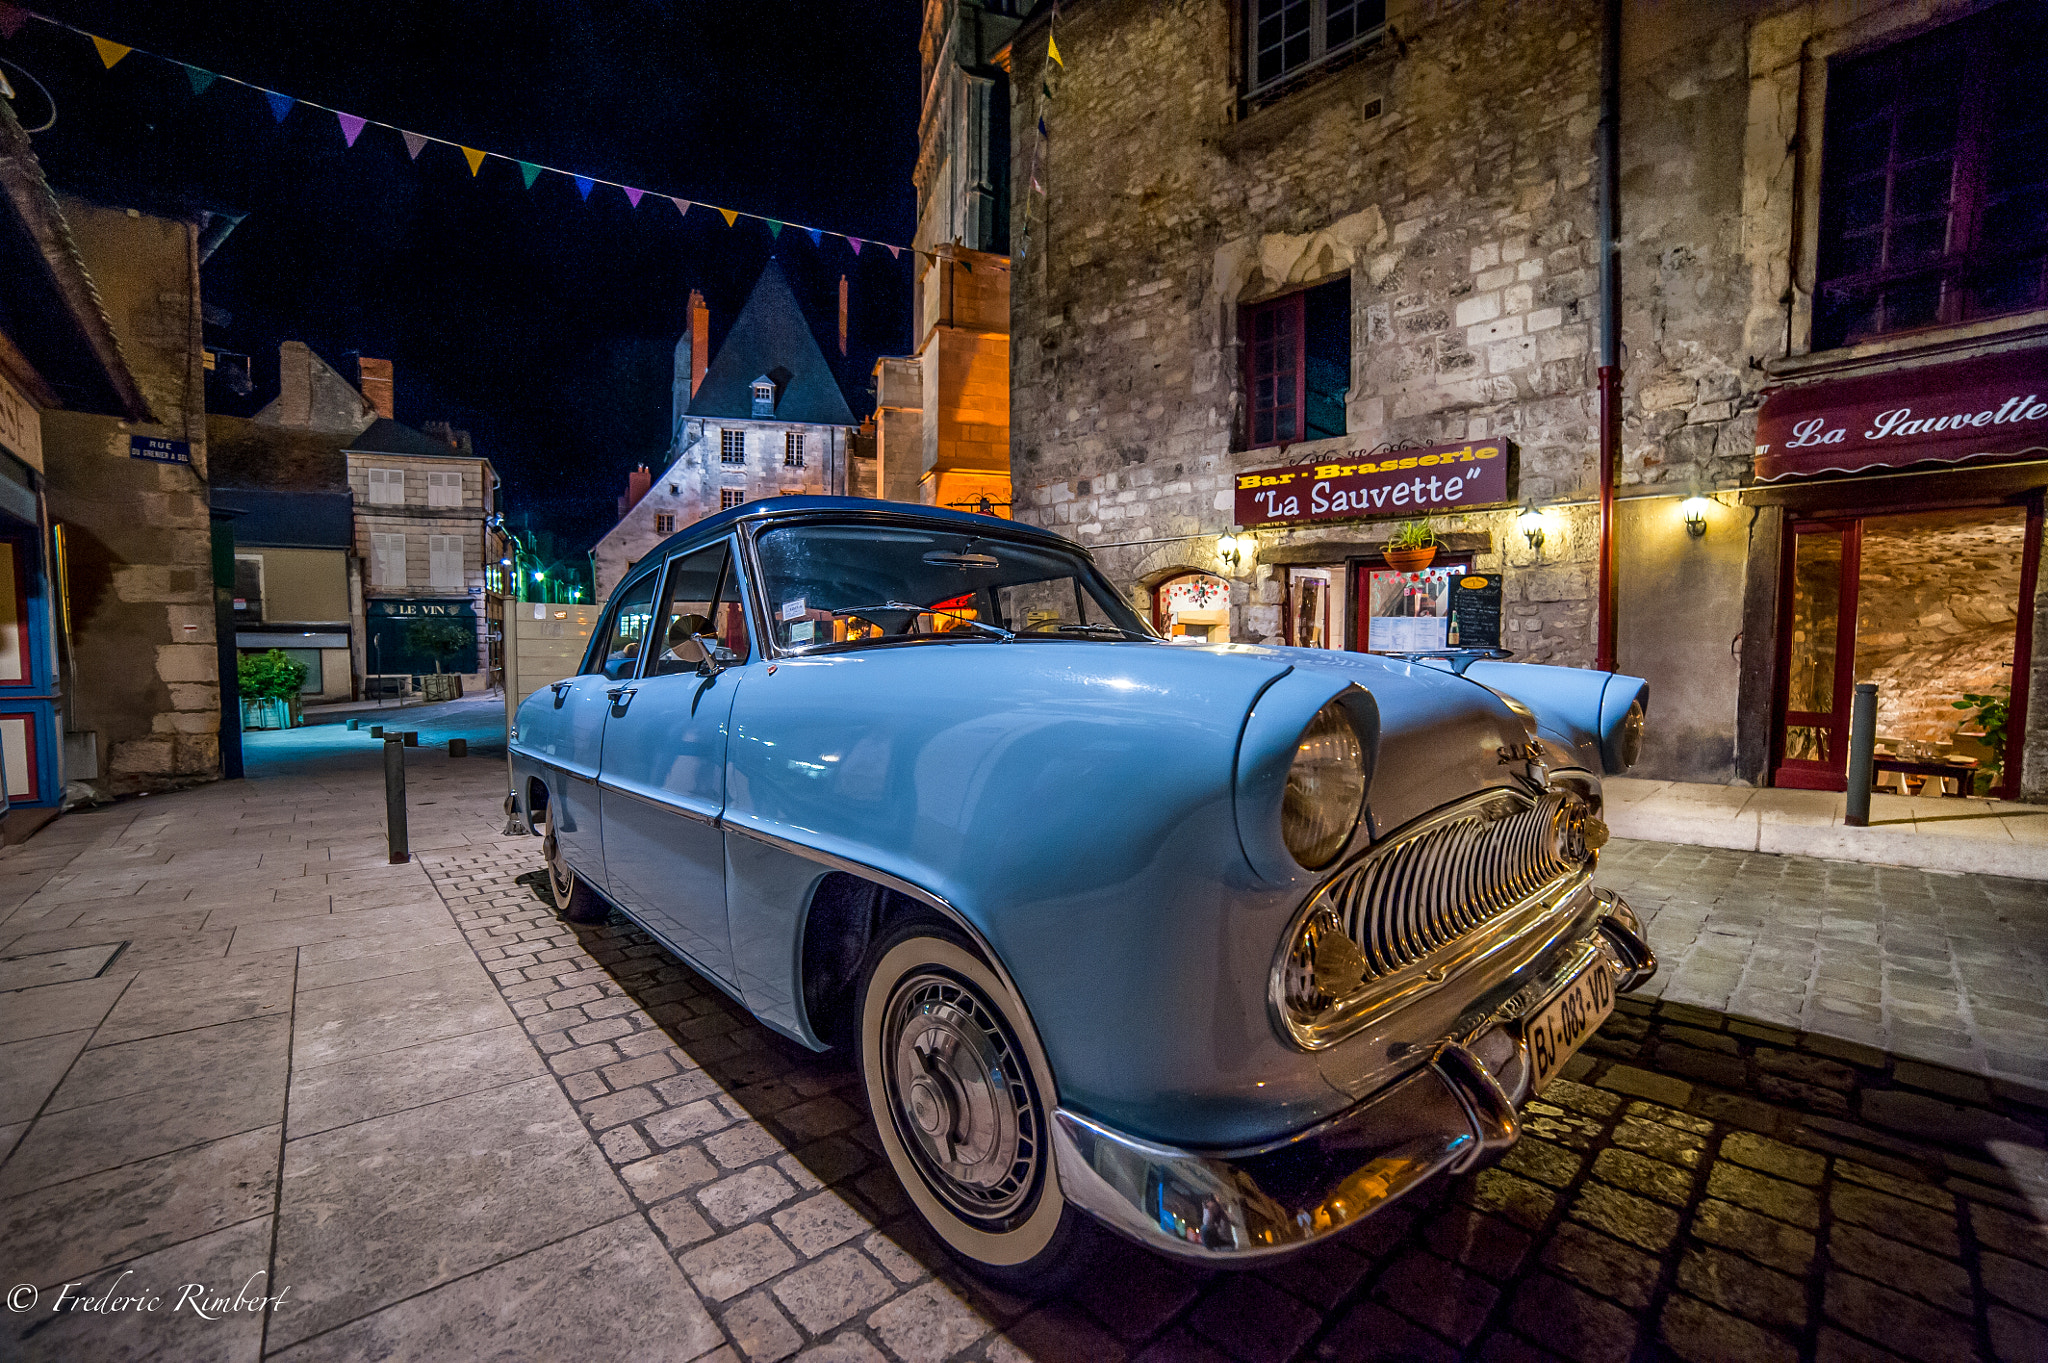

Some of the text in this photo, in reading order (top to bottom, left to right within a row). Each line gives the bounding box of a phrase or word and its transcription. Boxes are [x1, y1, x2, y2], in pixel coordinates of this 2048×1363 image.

[1785, 394, 2048, 448] La Sauvette
[149, 440, 172, 450] RUE
[1238, 473, 1296, 489] Bar
[1314, 446, 1499, 480] Brasserie
[399, 604, 445, 615] LE VIN
[1533, 964, 1610, 1080] BJ-083-VD
